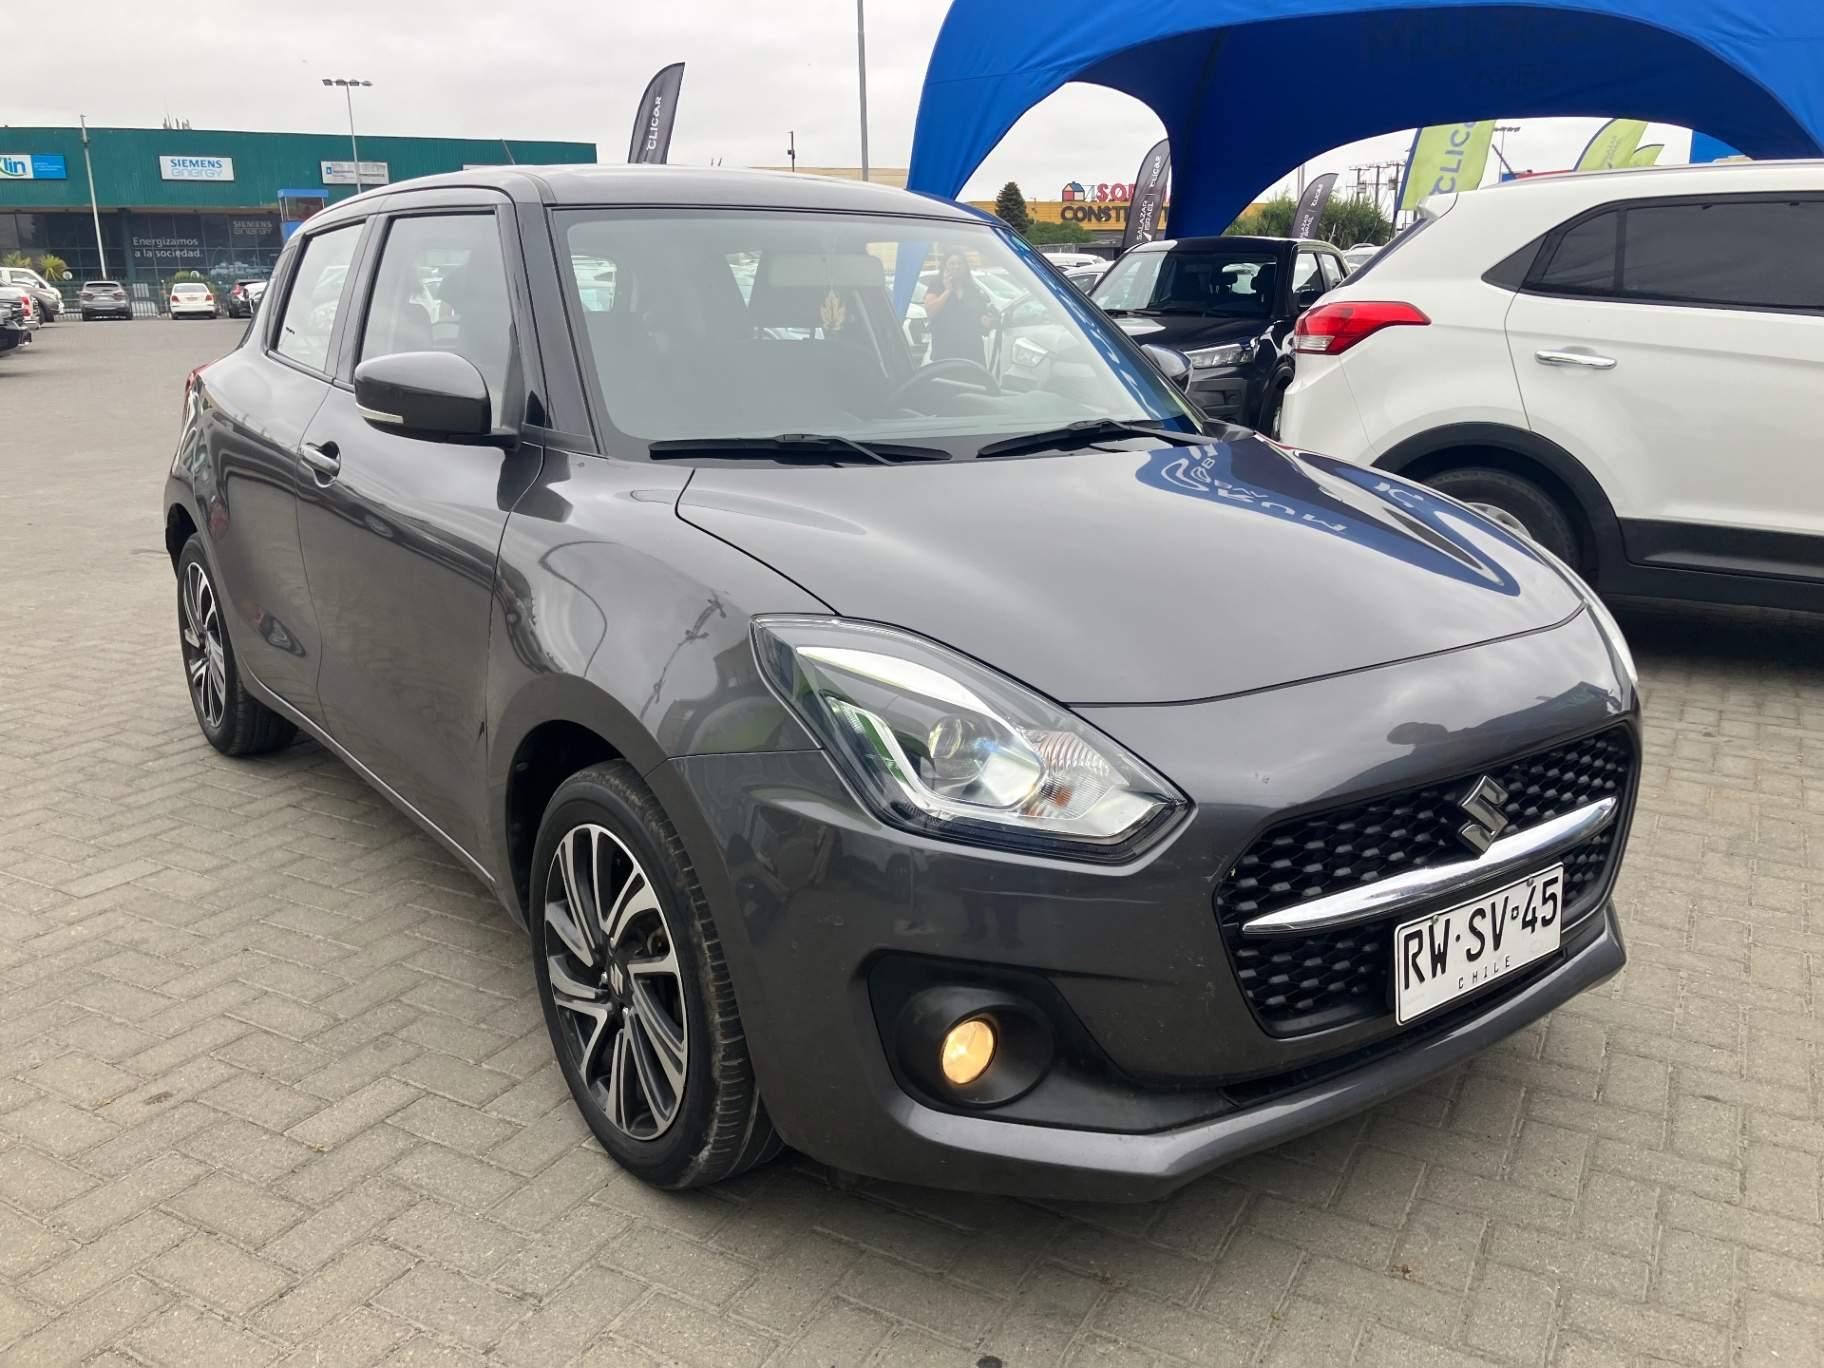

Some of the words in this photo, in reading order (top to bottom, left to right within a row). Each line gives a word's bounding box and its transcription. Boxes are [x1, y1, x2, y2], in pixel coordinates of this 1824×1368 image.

[170, 158, 223, 169] SIEMENS
[133, 236, 198, 248] Energizamos
[134, 250, 141, 258] a
[143, 248, 153, 258] la
[1458, 955, 1510, 990] CHILE
